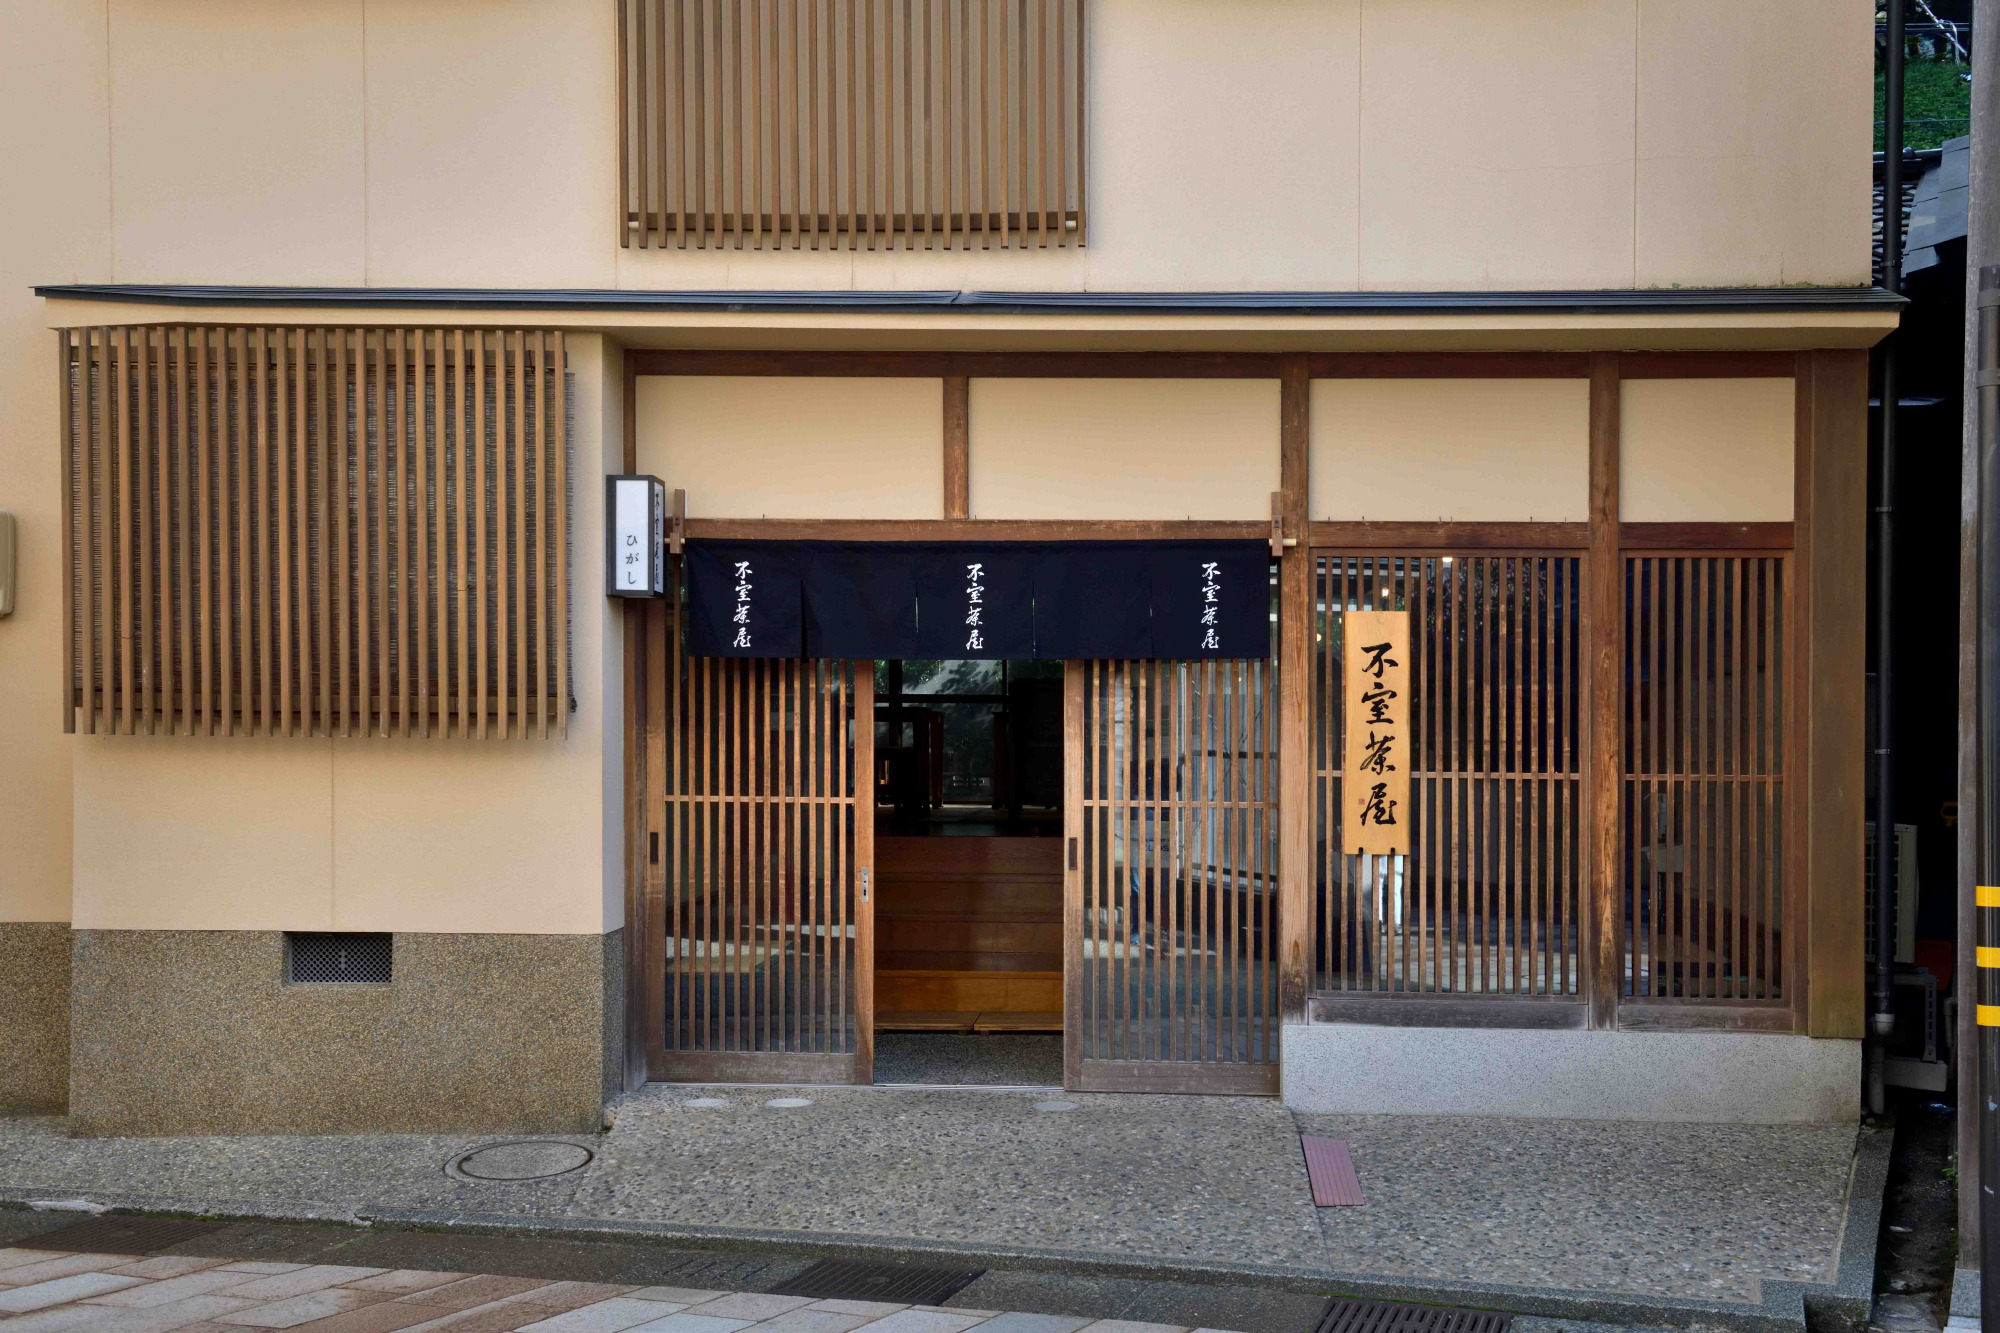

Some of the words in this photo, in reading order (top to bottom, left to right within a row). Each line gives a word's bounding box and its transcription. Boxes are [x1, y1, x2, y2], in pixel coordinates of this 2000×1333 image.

[625, 534, 639, 585] ひがし
[732, 560, 753, 648] 不室茶屋
[965, 563, 985, 651] 不室茶屋
[1200, 561, 1221, 649] 不室茶屋
[1359, 642, 1399, 827] 不室茶屋
